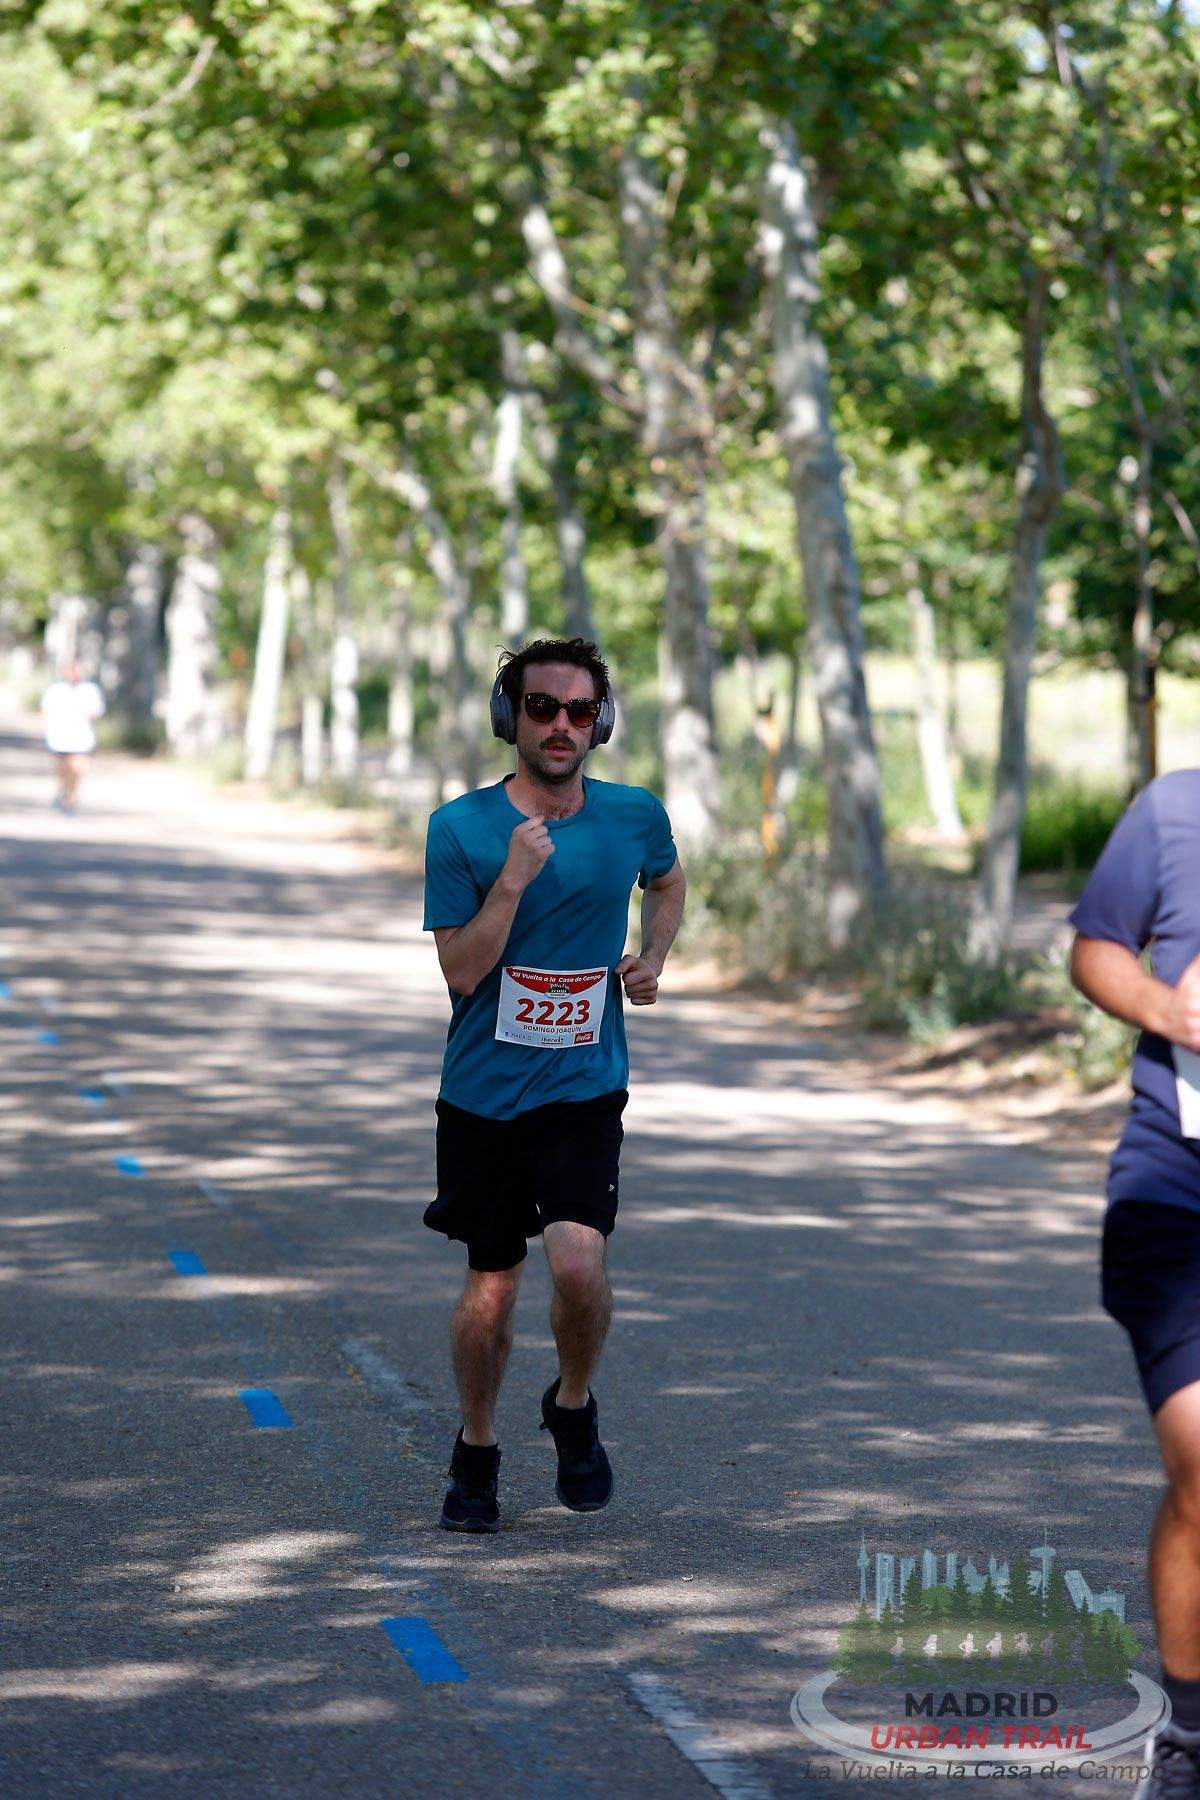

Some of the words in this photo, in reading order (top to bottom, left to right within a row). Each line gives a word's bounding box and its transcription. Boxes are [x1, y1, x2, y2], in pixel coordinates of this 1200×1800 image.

[522, 973, 543, 981] Vuelta
[549, 975, 556, 983] la
[575, 975, 582, 983] de
[583, 974, 602, 982] Campo
[515, 998, 591, 1025] 2223
[523, 1025, 555, 1033] DOMINGO
